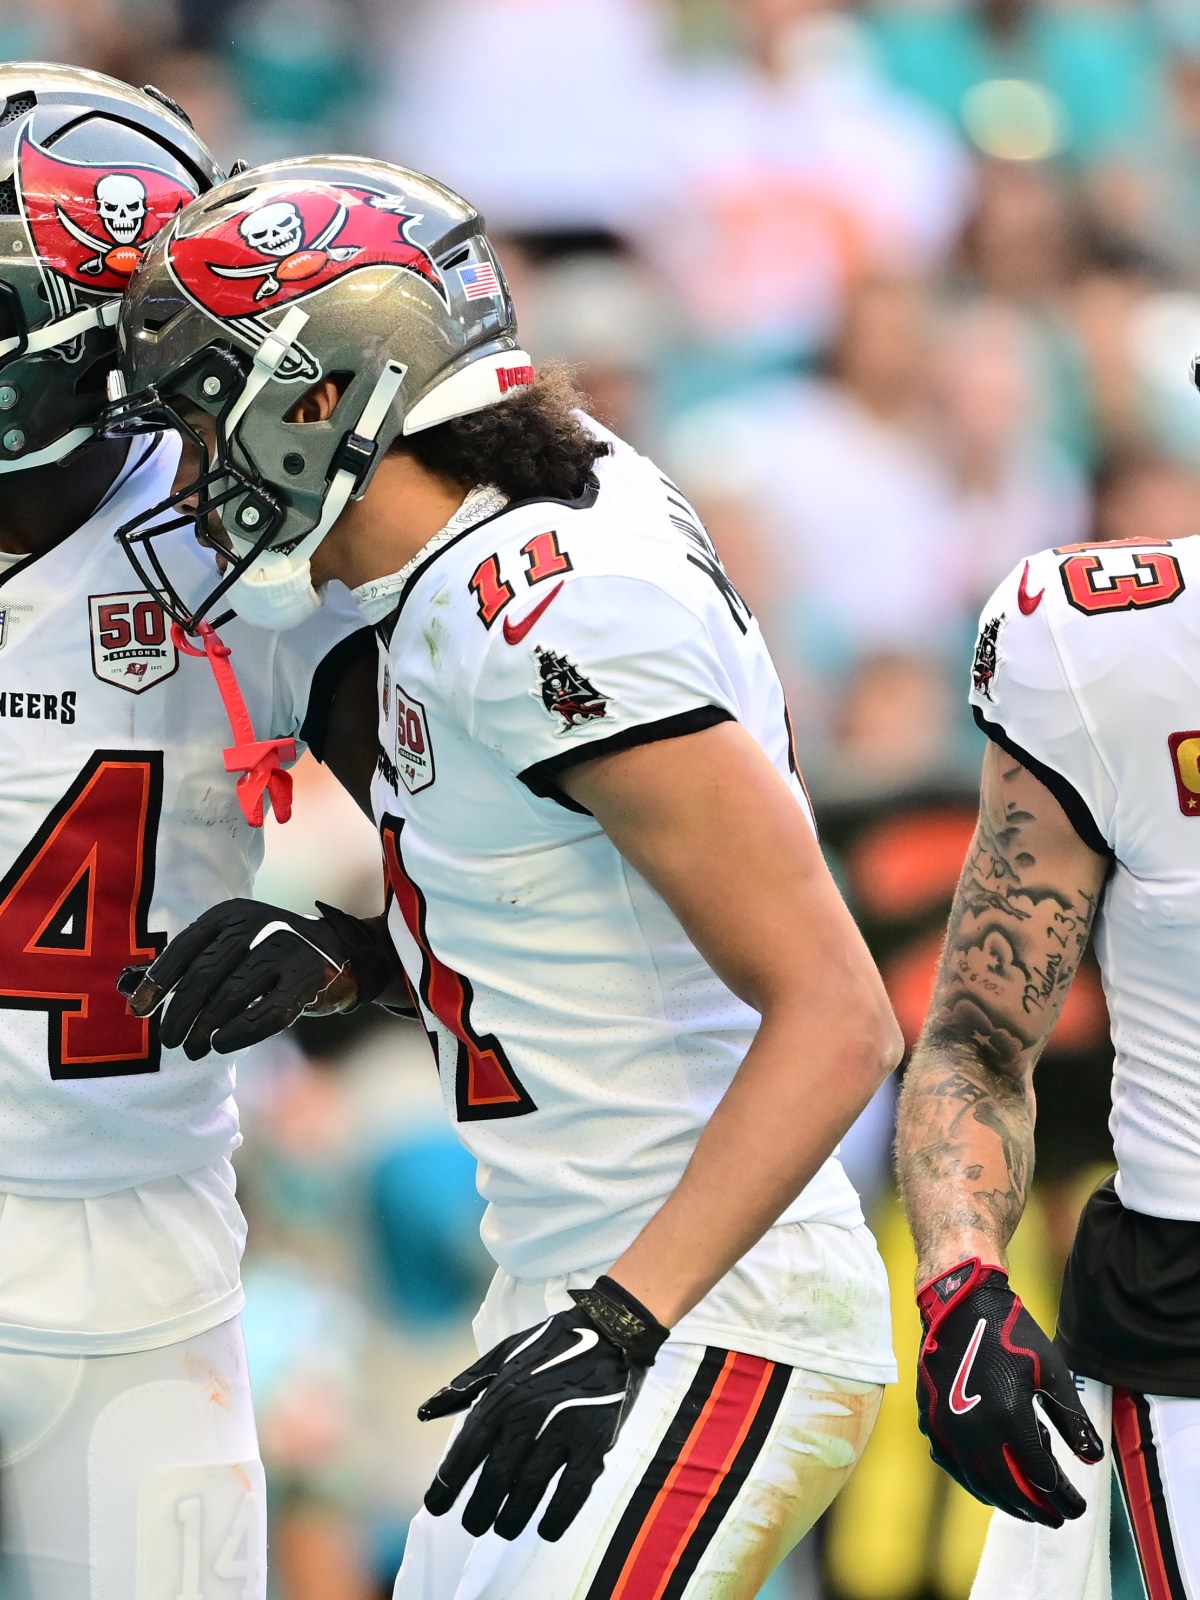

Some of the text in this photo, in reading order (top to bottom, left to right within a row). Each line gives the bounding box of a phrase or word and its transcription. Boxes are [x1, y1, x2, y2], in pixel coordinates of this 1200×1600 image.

[468, 531, 573, 630] 11
[98, 601, 166, 650] 50
[112, 649, 157, 659] SEASONS
[398, 699, 425, 755] 50
